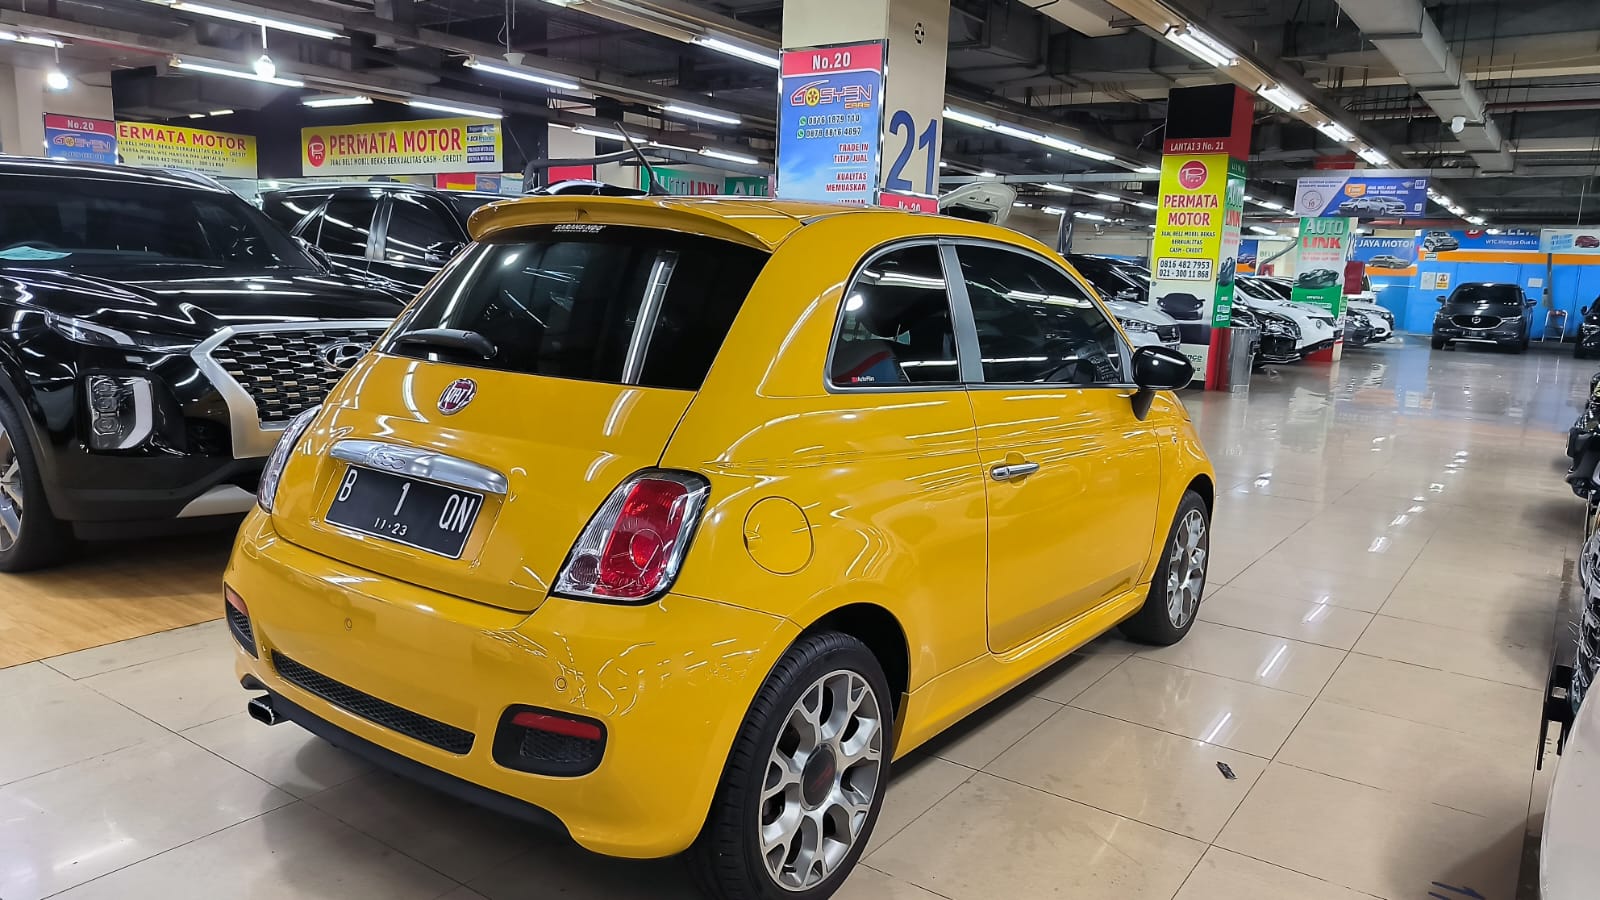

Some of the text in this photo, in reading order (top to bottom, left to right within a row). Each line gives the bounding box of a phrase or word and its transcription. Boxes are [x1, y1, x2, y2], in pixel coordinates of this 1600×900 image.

[812, 52, 851, 70] No.20
[68, 120, 94, 130] No.20
[119, 125, 246, 150] ERMATA MOTOR
[330, 128, 462, 155] PERMATA MOTOR
[886, 110, 937, 194] 21
[1170, 142, 1195, 151] LANTAI
[1202, 142, 1213, 150] No.
[1216, 142, 1224, 150] 21
[371, 157, 386, 165] BEKAS
[388, 155, 421, 164] BERKUALITAS
[837, 172, 866, 180] KUALITAS
[826, 184, 866, 192] MEMUASKAN
[1164, 195, 1218, 208] PERMATA
[1168, 213, 1210, 226] MOTOR
[1304, 218, 1344, 235] AUTO
[1303, 236, 1341, 249] LINK
[444, 387, 469, 403] FIAT
[338, 469, 476, 533] B 1 QN
